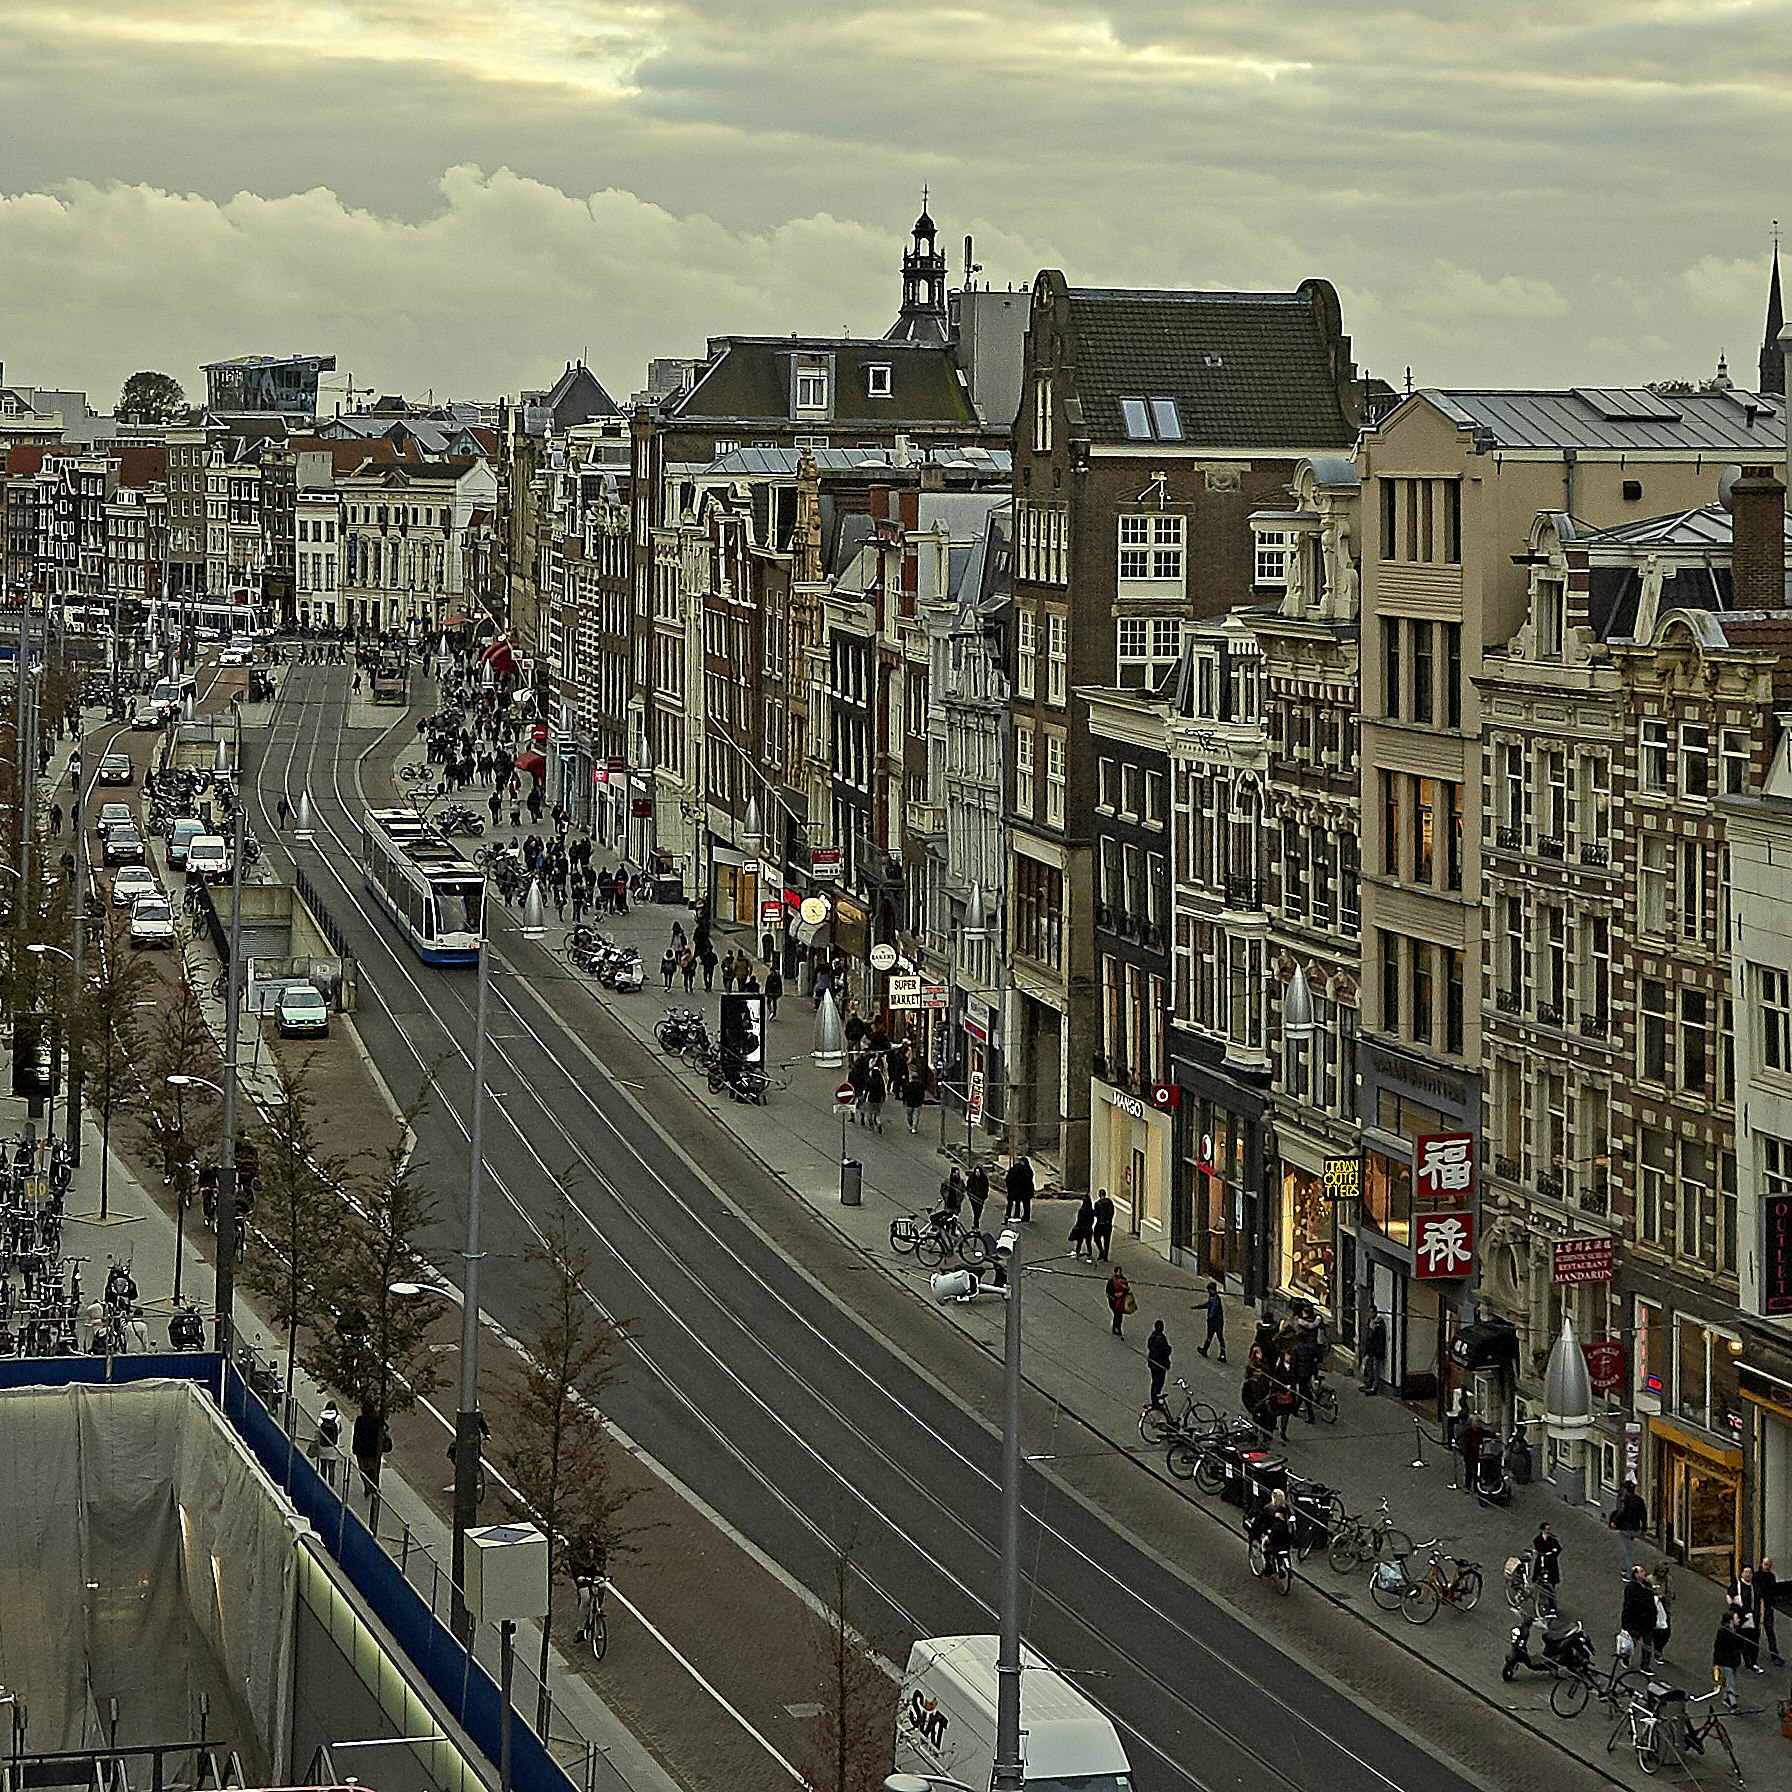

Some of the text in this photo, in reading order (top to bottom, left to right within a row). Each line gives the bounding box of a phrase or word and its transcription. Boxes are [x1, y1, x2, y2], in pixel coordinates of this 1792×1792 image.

[894, 979, 917, 990] SUPER
[890, 993, 920, 1006] MARKET
[1113, 1091, 1143, 1118] MANGO
[1418, 1138, 1472, 1191] 福
[1774, 1202, 1789, 1294] OUTLET
[1558, 1260, 1609, 1271] RESTAURANT
[1554, 1269, 1612, 1283] MANDARIJN
